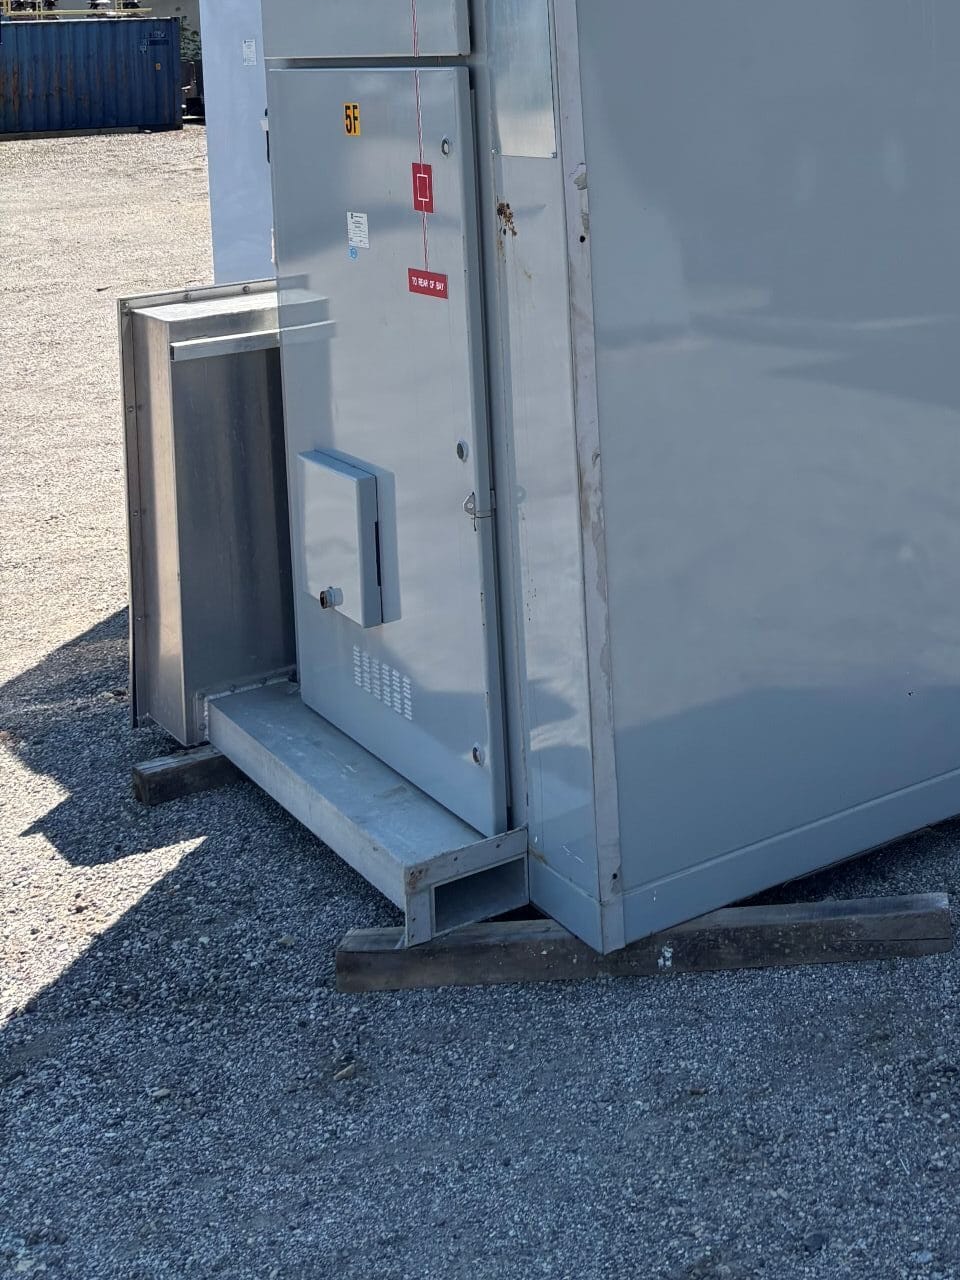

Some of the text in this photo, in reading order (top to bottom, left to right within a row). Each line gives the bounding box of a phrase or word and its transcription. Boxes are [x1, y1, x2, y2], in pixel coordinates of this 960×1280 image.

[345, 104, 359, 134] 5F
[411, 276, 445, 291] TO REAR OF BAY
